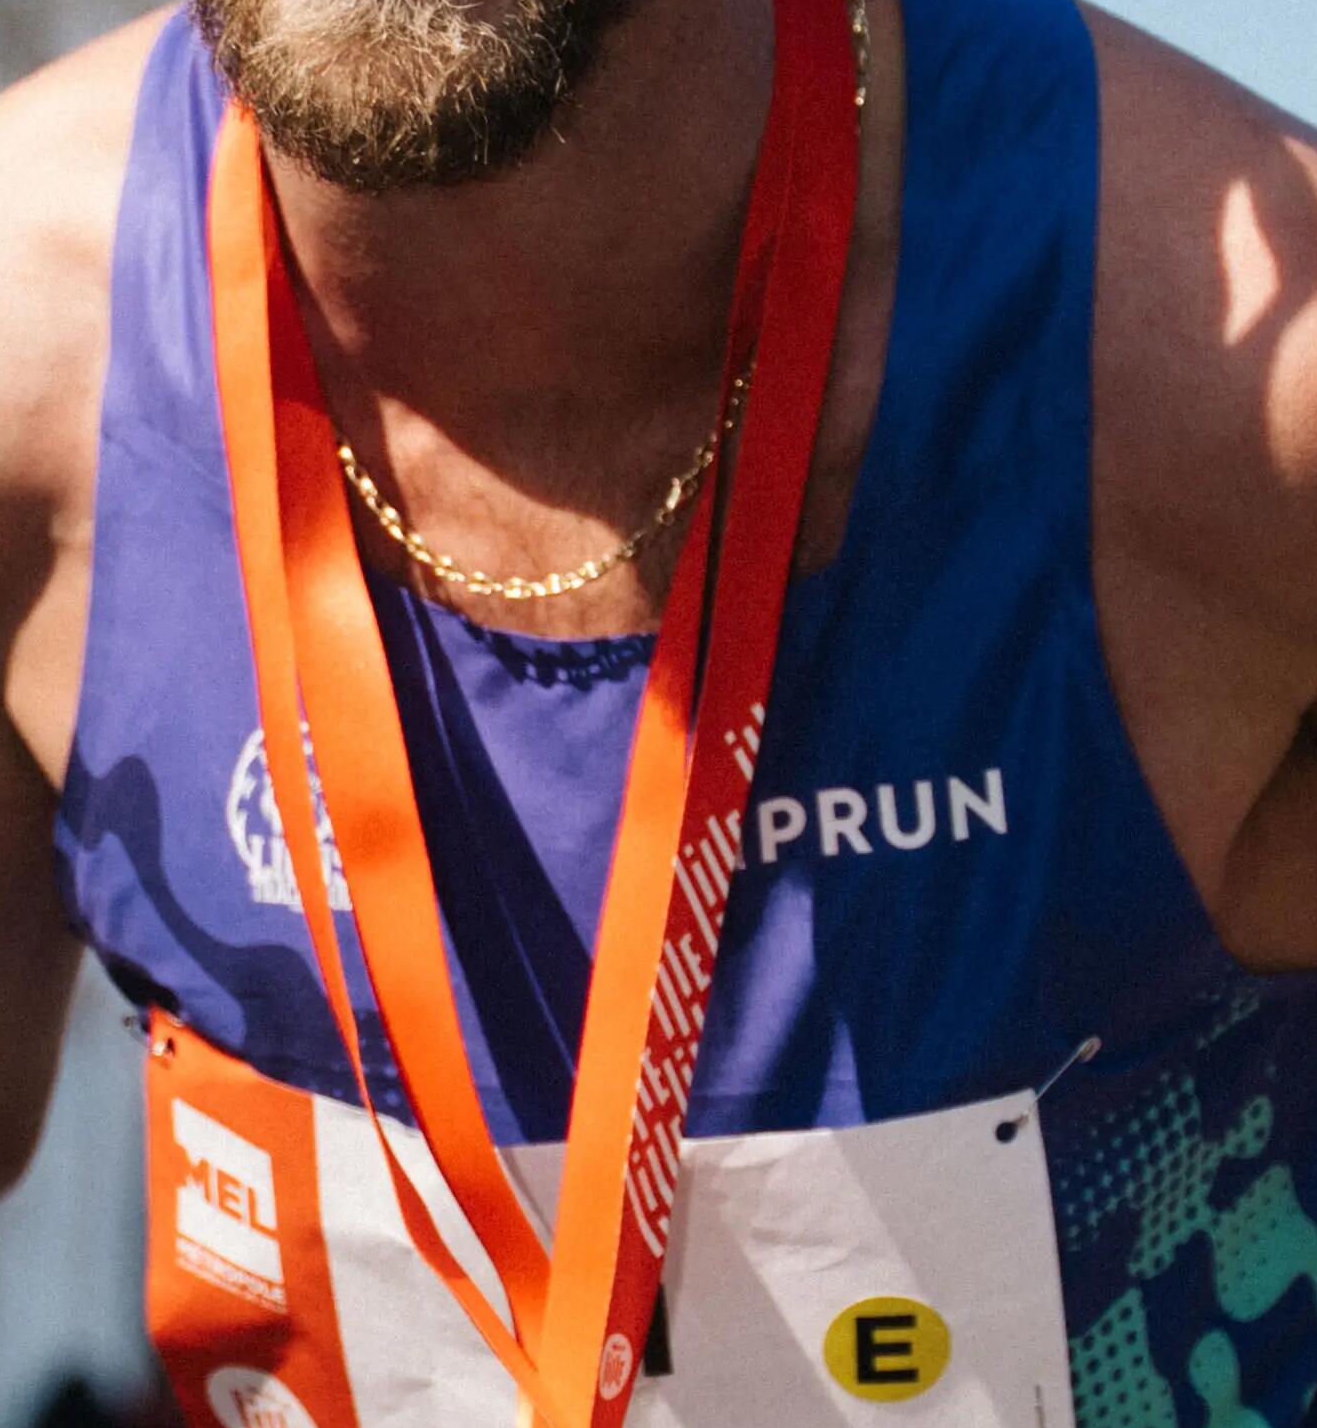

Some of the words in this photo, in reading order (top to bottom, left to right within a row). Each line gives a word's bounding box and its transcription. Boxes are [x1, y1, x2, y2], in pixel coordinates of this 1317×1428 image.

[743, 767, 1008, 869] PRUN
[176, 1143, 281, 1242] MEL
[855, 1313, 920, 1385] E
